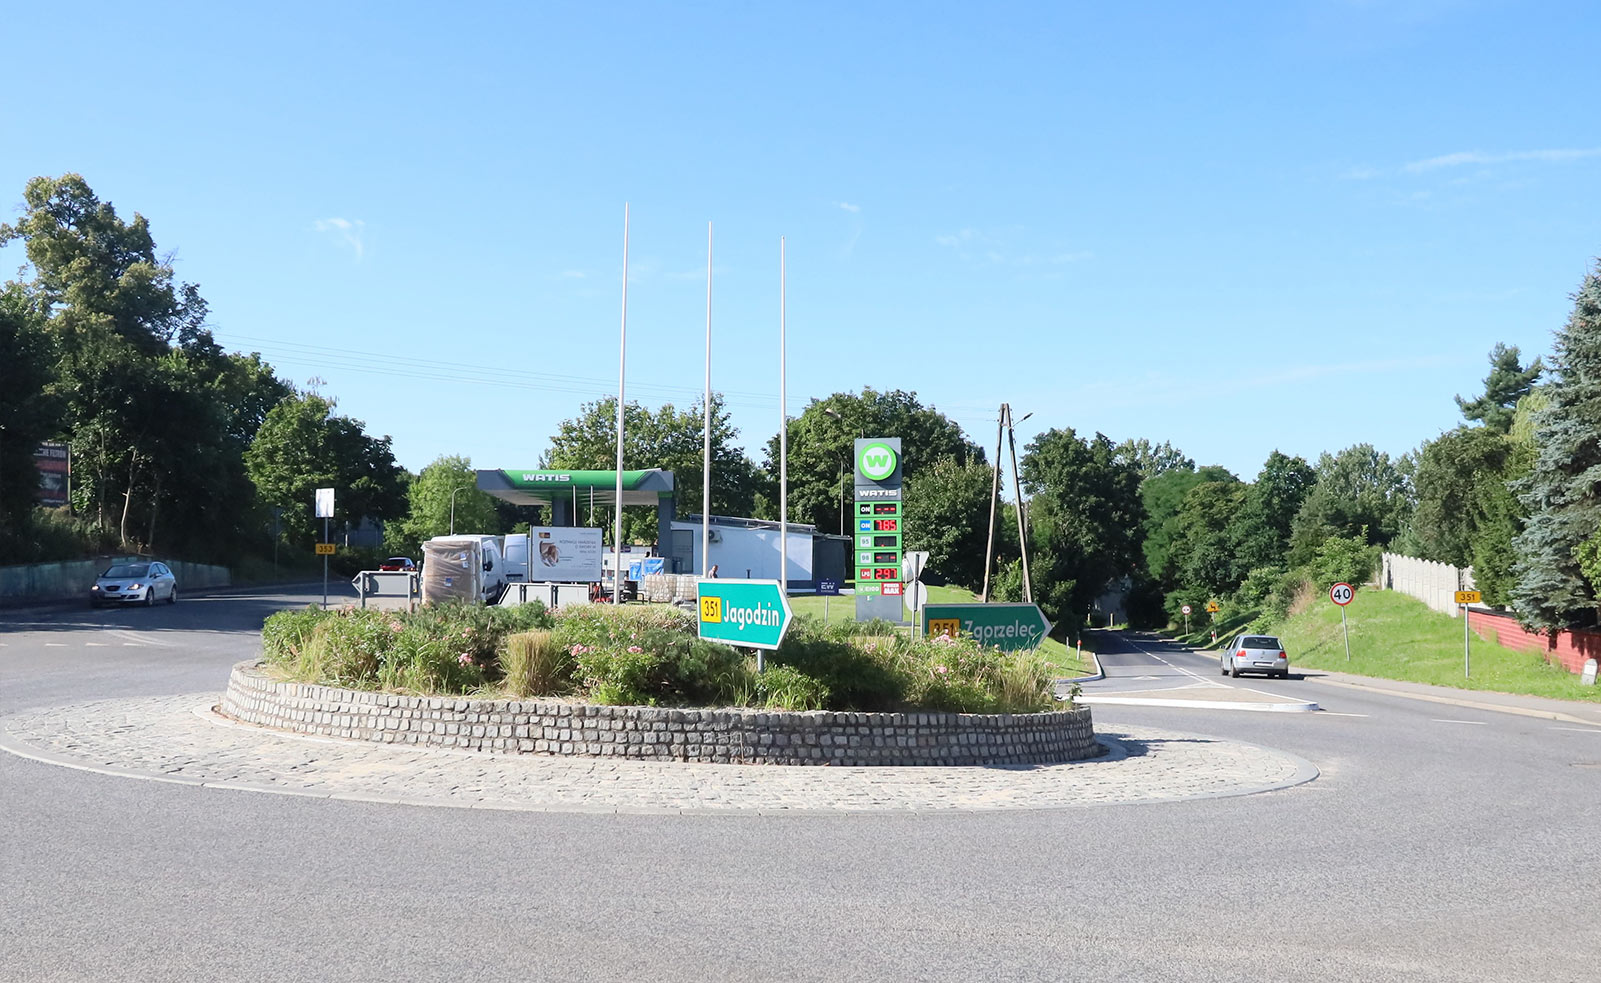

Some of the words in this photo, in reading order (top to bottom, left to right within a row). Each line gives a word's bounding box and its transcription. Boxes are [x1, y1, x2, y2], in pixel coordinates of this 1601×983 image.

[522, 474, 570, 482] WATIS
[875, 520, 897, 531] 785
[875, 569, 897, 580] 297
[1333, 588, 1351, 600] 40
[1460, 593, 1475, 601] 351
[704, 600, 719, 617] 351
[723, 600, 780, 631] Jagodzin
[964, 619, 1036, 643] Zgorzelec
